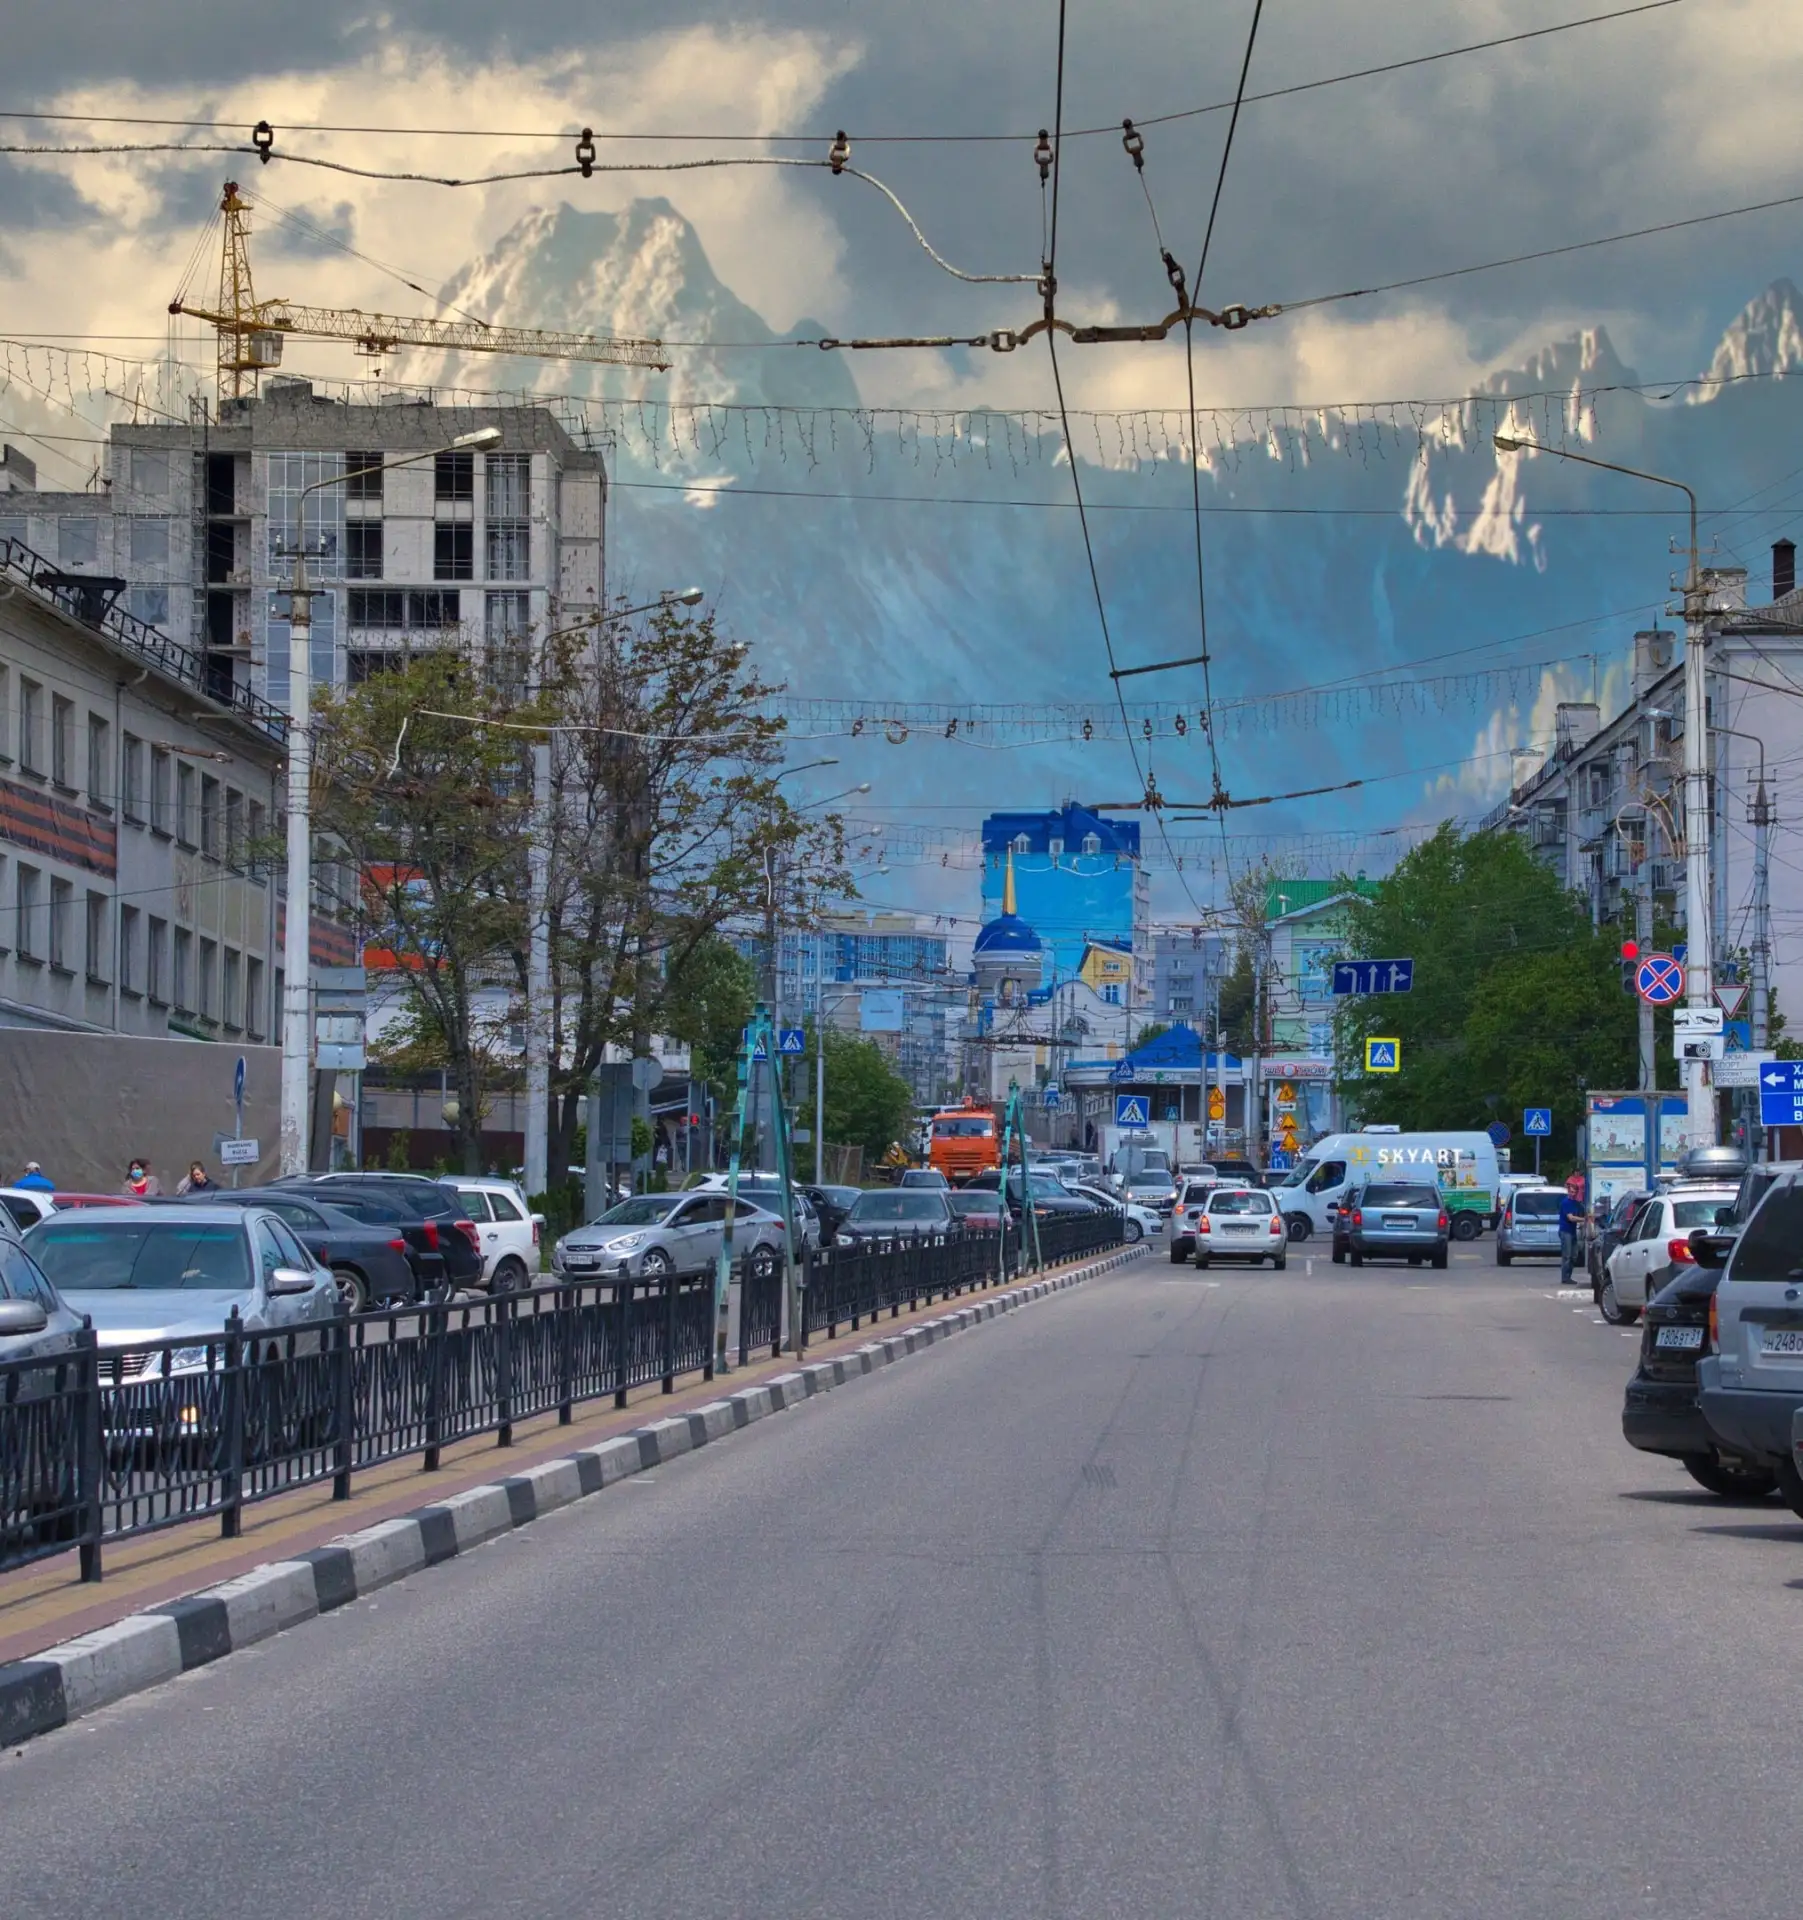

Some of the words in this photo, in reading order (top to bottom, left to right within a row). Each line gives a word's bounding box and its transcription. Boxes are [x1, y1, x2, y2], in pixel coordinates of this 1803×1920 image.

[1722, 1053, 1748, 1061] ОКЗАЛ
[1793, 1064, 1803, 1075] Х
[1378, 1148, 1464, 1164] SKYART
